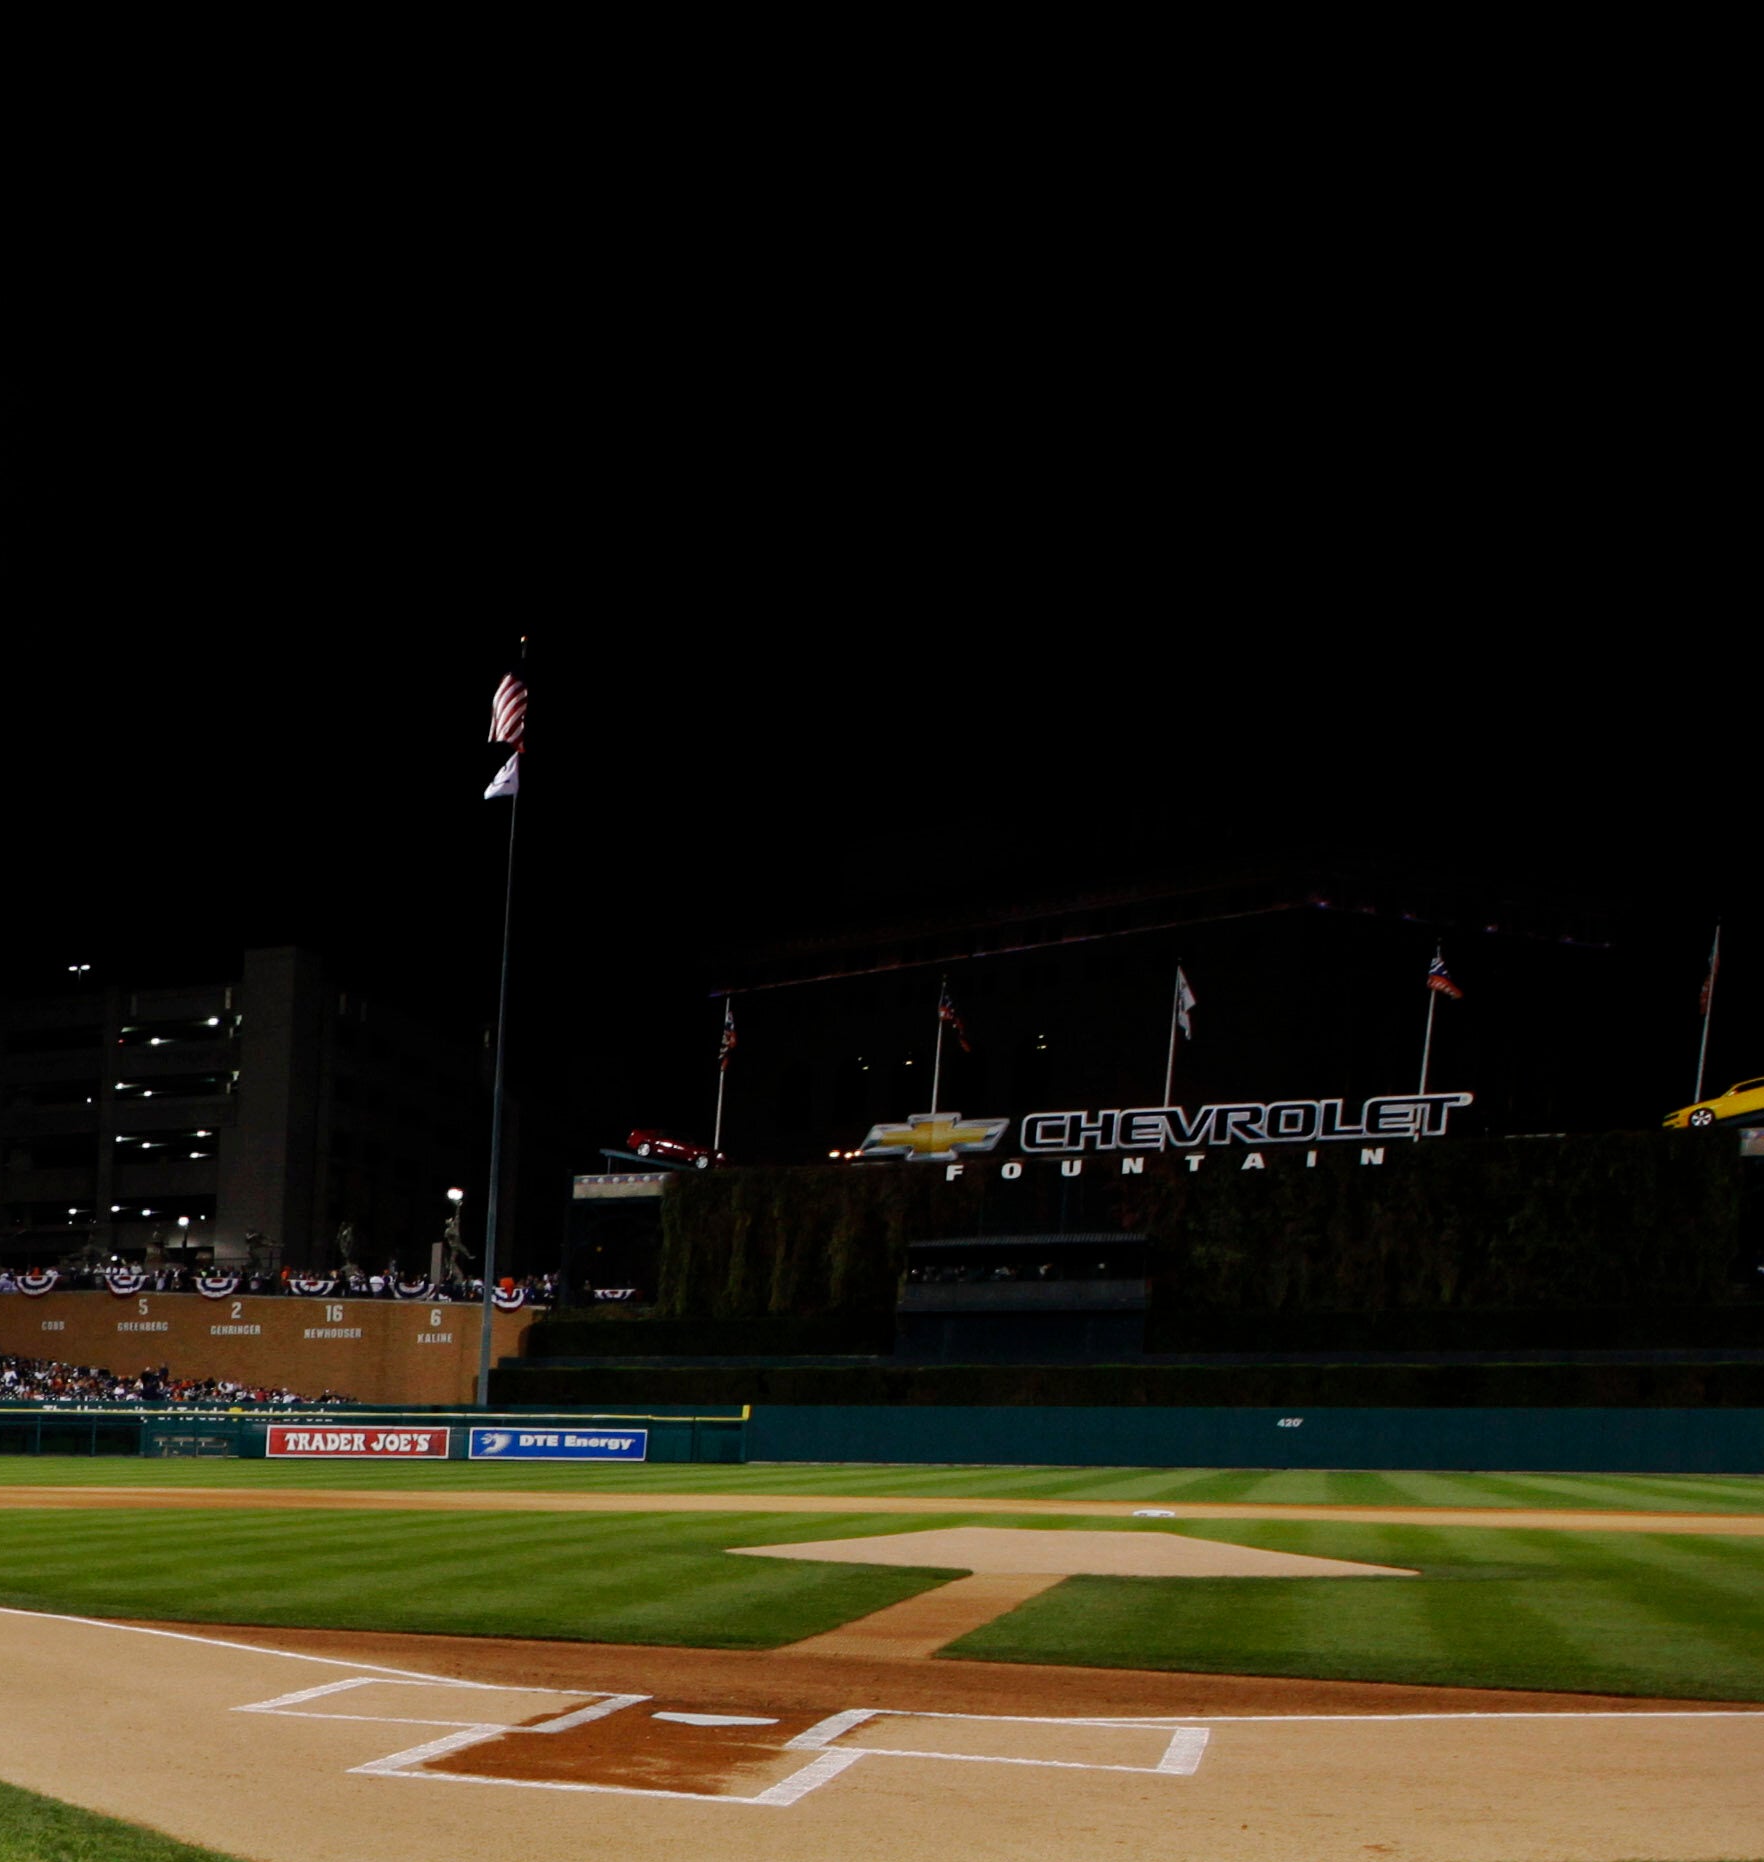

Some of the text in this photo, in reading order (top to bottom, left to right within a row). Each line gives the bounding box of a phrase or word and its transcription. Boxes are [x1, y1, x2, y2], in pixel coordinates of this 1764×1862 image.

[1021, 1092, 1473, 1153] CHEVROLET
[946, 1147, 1386, 1182] FOUNTAIN
[138, 1299, 149, 1315] 5
[231, 1302, 242, 1319] 2
[326, 1305, 344, 1322] 16
[430, 1309, 442, 1326] 6
[117, 1322, 169, 1332] GREENBERG
[417, 1333, 452, 1343] KALINE
[284, 1433, 432, 1452] TRADER JOE'S
[519, 1434, 632, 1450] DTE Energy
